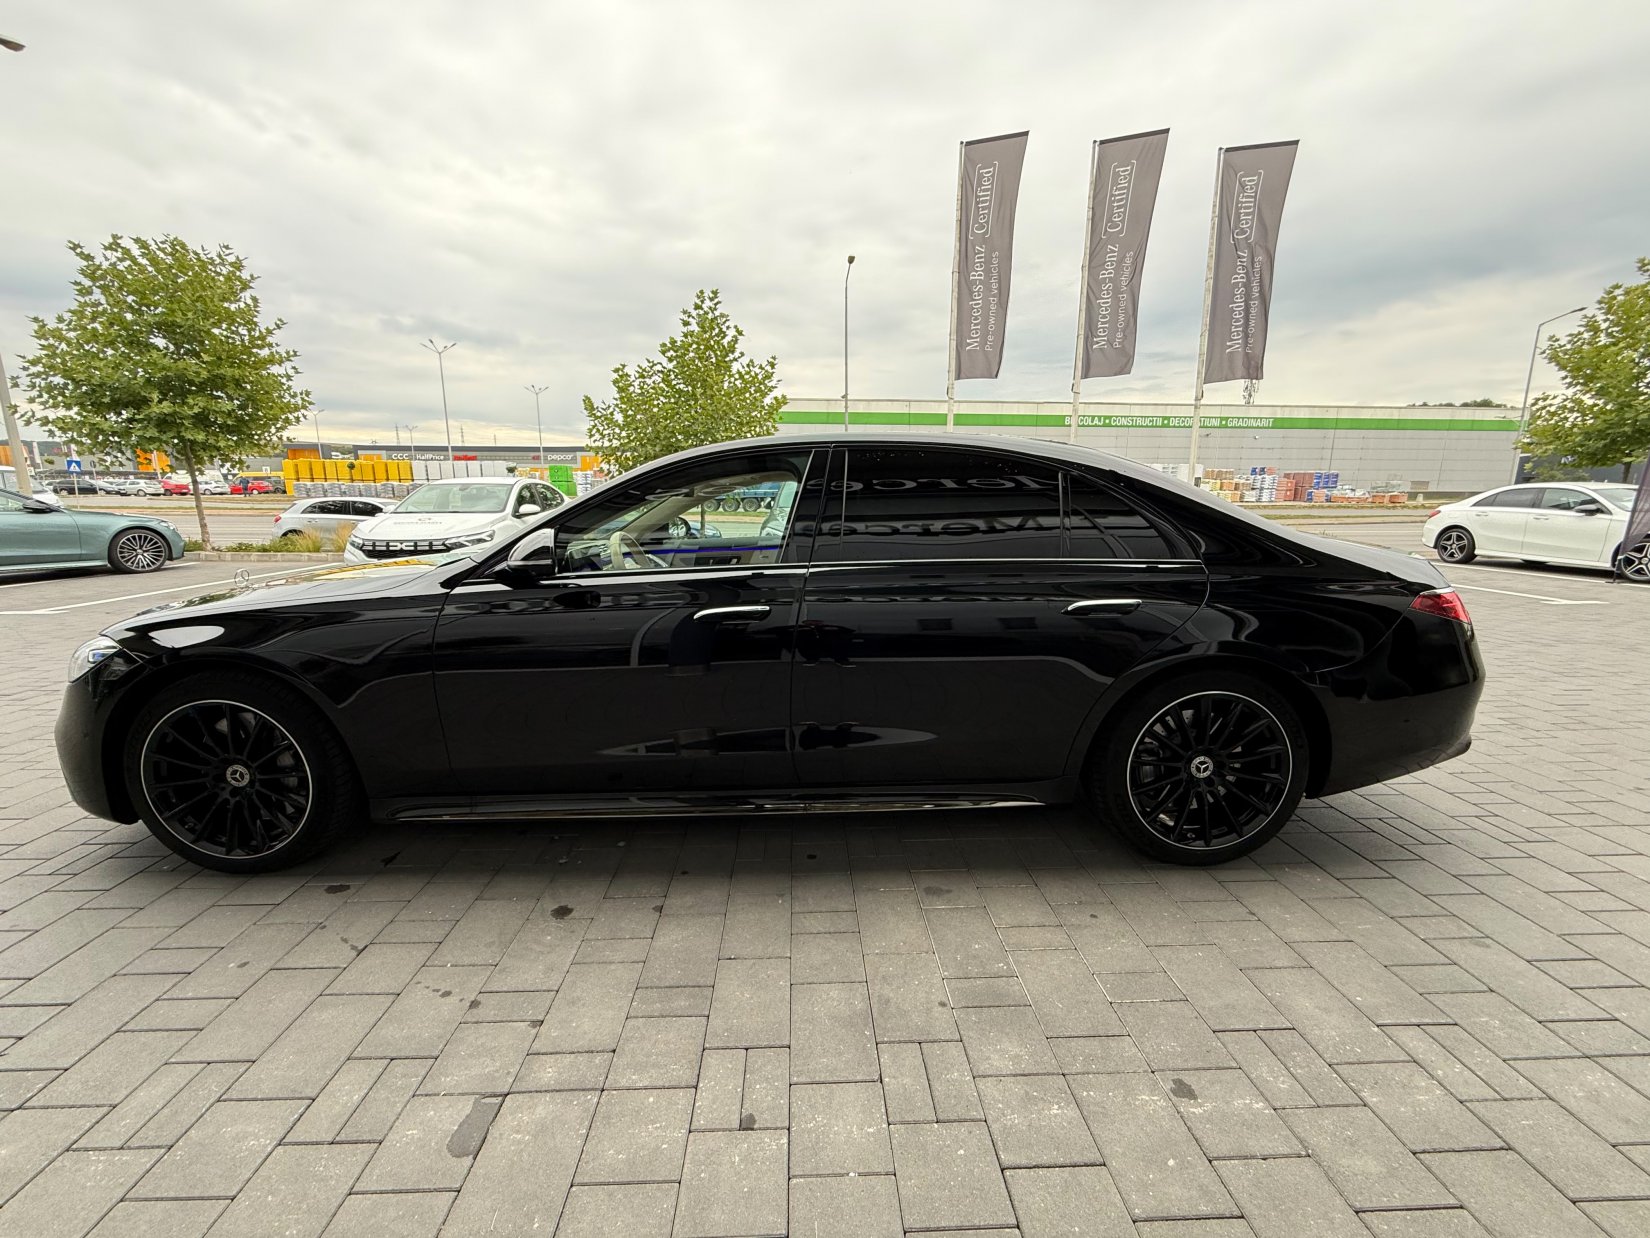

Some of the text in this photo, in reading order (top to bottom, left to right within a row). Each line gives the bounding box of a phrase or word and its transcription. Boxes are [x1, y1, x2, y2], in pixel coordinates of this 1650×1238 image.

[966, 167, 994, 351] Mercedes-Benz Certified
[985, 251, 999, 351] Pre-owned vehicles
[1093, 166, 1131, 349] Mercedes-Benz Certified
[1113, 251, 1134, 348] Pre-owned vehicles
[1226, 176, 1258, 354] Mercedes-Benz Certified
[1246, 256, 1262, 353] Pre-owned vehicles
[1065, 416, 1104, 426] BCOLAJ
[1111, 417, 1162, 426] CONSTRUCTII
